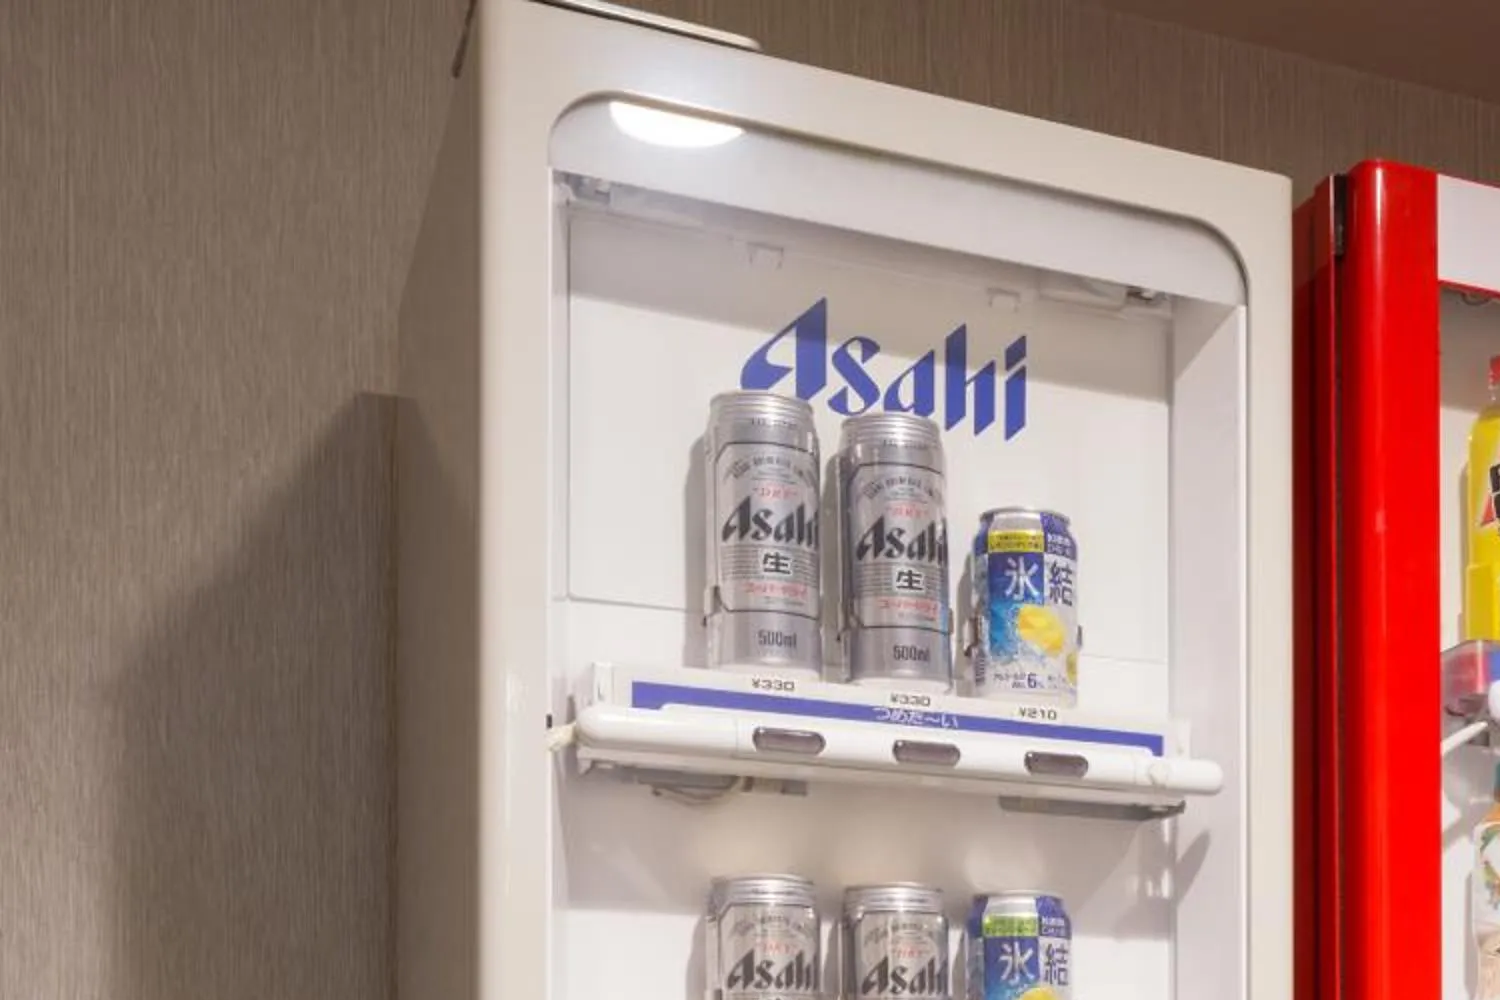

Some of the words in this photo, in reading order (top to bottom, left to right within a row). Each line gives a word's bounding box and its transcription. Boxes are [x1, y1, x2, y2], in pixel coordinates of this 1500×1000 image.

[740, 297, 1027, 441] Asahi
[762, 552, 792, 575] 生
[896, 570, 925, 591] 生
[1005, 557, 1074, 607] 氷結
[758, 631, 797, 648] 500ml
[893, 645, 931, 662] 500ml
[752, 678, 795, 691] ¥330
[890, 693, 931, 707] ¥330
[1019, 707, 1057, 720] ¥210
[999, 940, 1068, 987] 氷結
